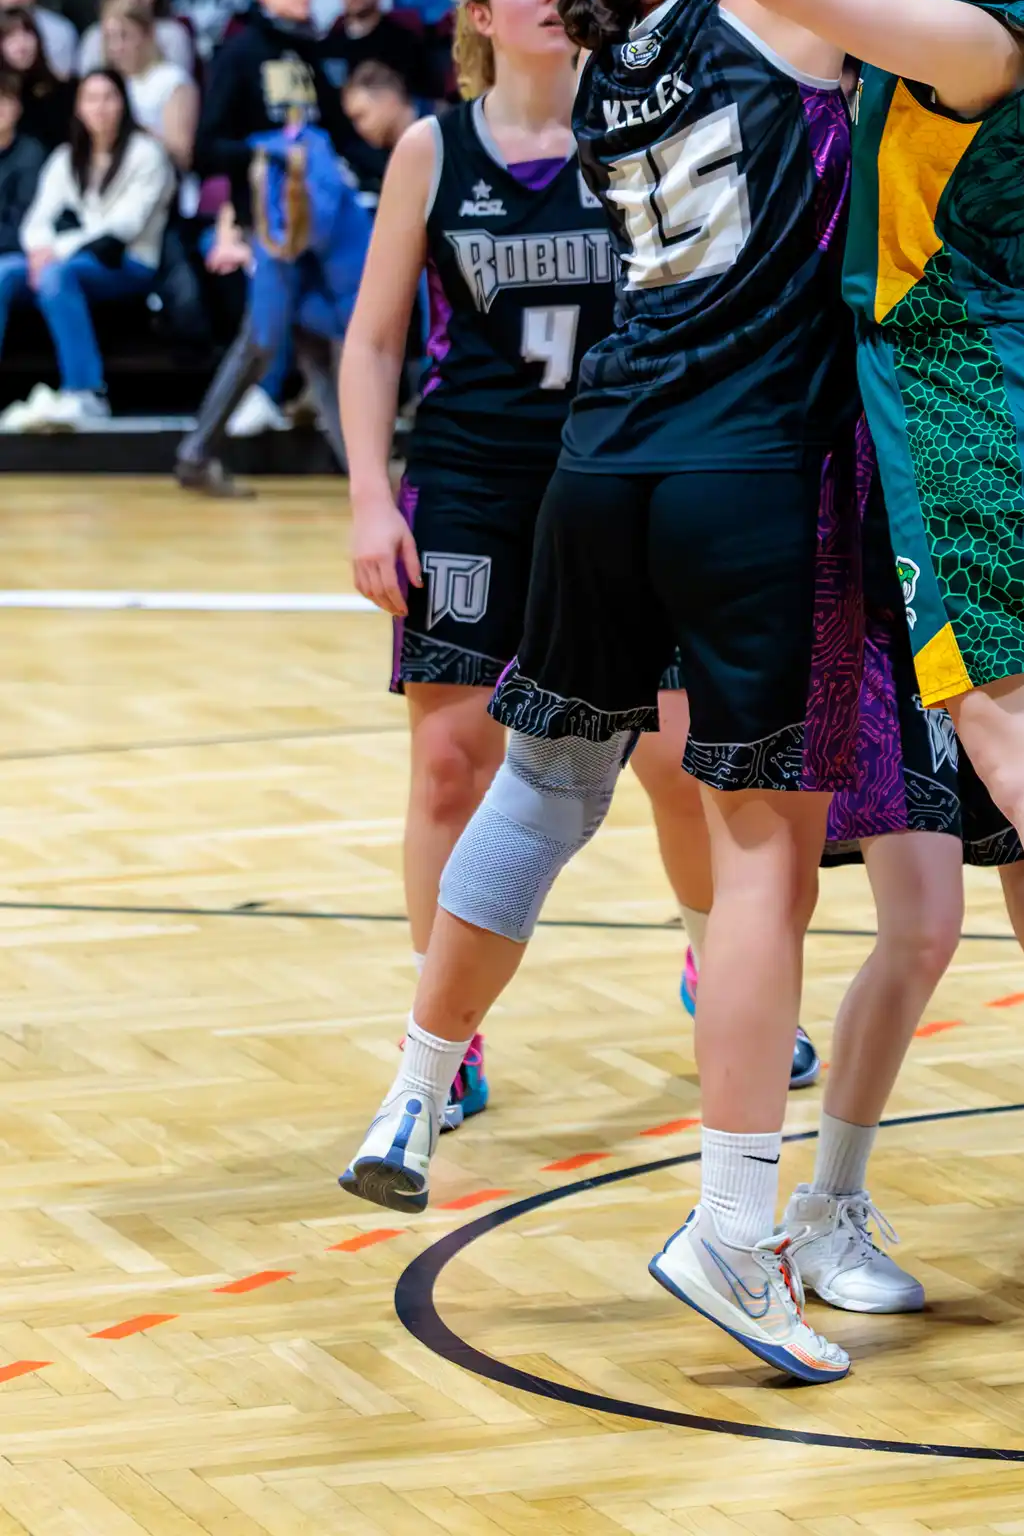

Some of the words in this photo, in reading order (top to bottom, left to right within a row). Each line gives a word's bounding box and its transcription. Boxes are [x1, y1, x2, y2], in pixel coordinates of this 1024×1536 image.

[606, 103, 751, 291] 15
[520, 304, 581, 390] 4
[422, 551, 492, 632] TU
